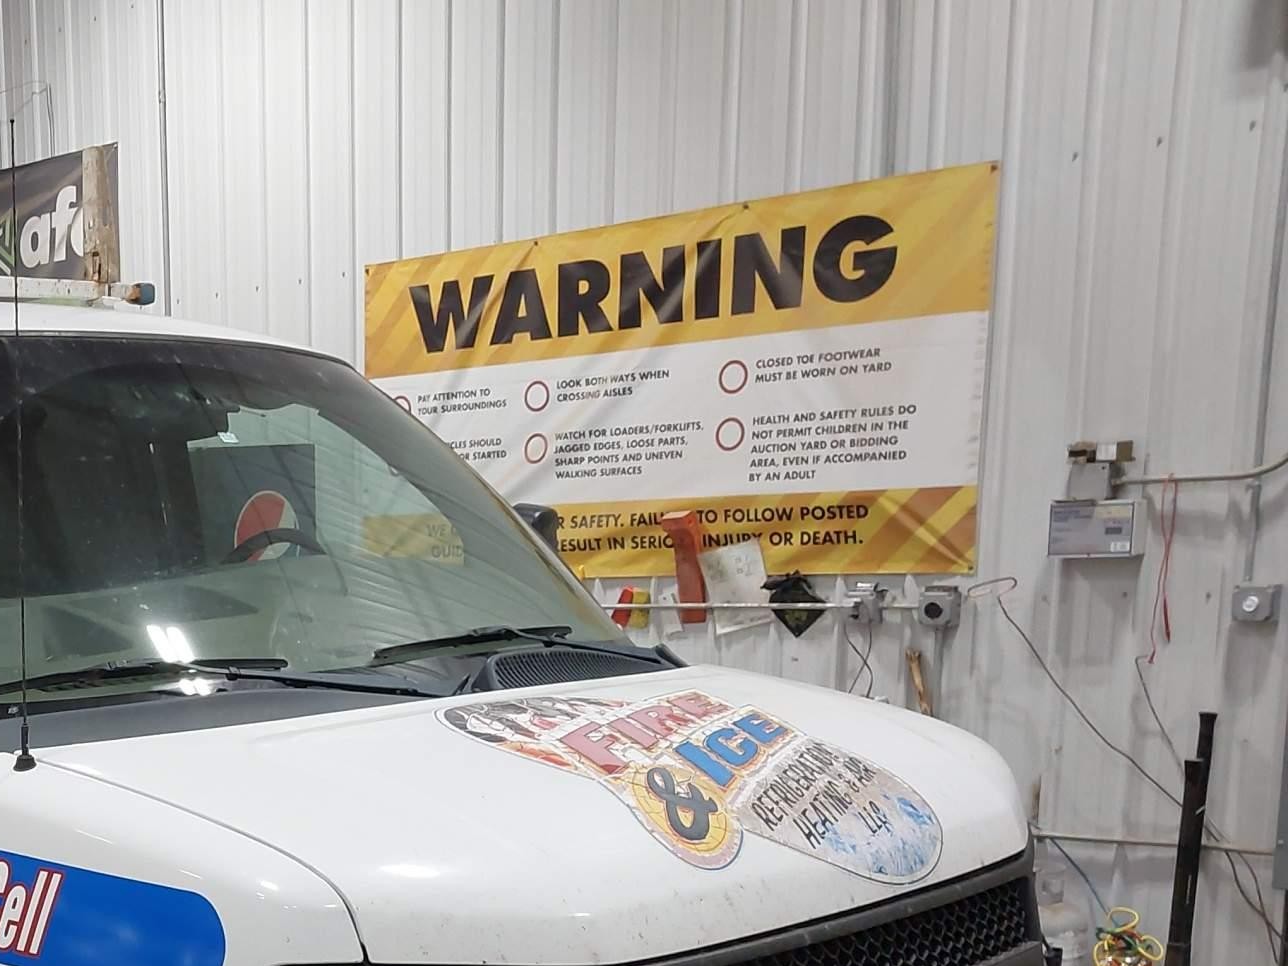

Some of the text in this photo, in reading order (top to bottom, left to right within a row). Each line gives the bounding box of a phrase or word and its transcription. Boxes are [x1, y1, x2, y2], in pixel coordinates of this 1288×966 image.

[409, 214, 899, 355] WARNING
[755, 347, 881, 370] CLOSED TOE FOOTWEAR
[556, 369, 670, 390] LOOK BOTH WAYS WHEN
[754, 361, 892, 383] MUST BE WORN ON YARD
[417, 388, 491, 403] PAY ATTENTION TO
[556, 386, 633, 402] CROSSING AISLES
[417, 398, 507, 416] YOUR SURROUNDINGS
[752, 404, 918, 426] HEALTH AND SAFETY RULES DO
[555, 421, 704, 441] WATCH FOR LOADERS/FORKLIFTS,
[751, 420, 910, 441] NOT PERMIT CHILDREN IN THE
[468, 437, 502, 448] SHOULD
[553, 435, 688, 455] JAGGED EDGES, LOOSE PARTS,
[750, 435, 899, 454] AUCTION YARD OR BIDDING
[472, 449, 507, 460] STARTED
[554, 450, 683, 467] SHARP POINTS AND UNEVEN
[749, 450, 907, 469] AREA, EVEN IF ACCOMPANIED
[555, 465, 643, 480] WALKING SURFACES
[748, 469, 817, 483] BY AN ADULT
[570, 513, 625, 529] SAFETY.
[630, 511, 664, 527] FAIL
[696, 509, 718, 524] TO
[724, 507, 794, 525] FOLLOW
[800, 504, 869, 521] POSTED
[558, 538, 602, 553] ESULT
[607, 537, 626, 550] IN
[630, 533, 674, 550] SERIO
[769, 531, 794, 547] OR
[800, 530, 864, 546] DEATH.
[559, 690, 736, 775] FIRE
[646, 712, 789, 841] & ICE
[792, 779, 853, 850] HEATING
